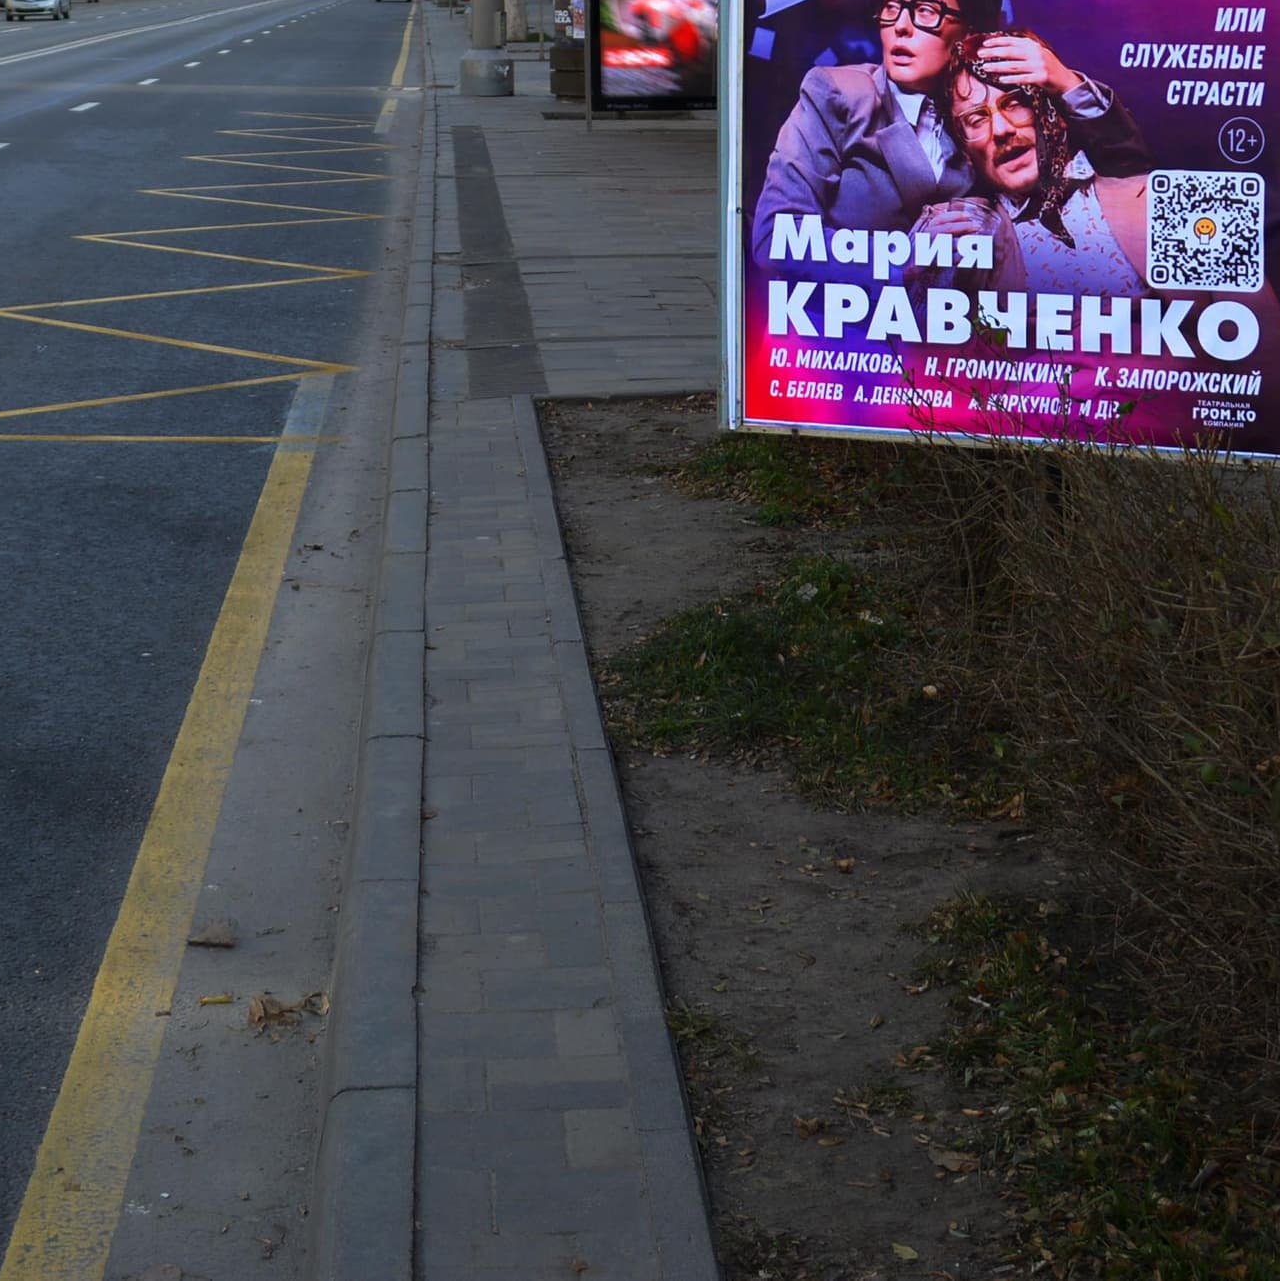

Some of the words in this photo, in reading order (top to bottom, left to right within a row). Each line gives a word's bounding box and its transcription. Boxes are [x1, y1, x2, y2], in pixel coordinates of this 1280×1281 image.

[1215, 7, 1265, 32] ИЛИ
[1120, 42, 1265, 70] СЛУЖЕБНЫЕ
[1166, 81, 1264, 107] СТРАСТИ
[1227, 128, 1258, 153] 12+
[769, 213, 993, 281] Мария
[768, 281, 1260, 361] КРАВЧЕНКО
[770, 349, 792, 368] Ю.
[796, 351, 905, 375] МИХАЛКОВА
[925, 357, 942, 376] Н.
[1095, 366, 1113, 387] К.
[1117, 367, 1262, 396] ЗАПОРОЖСКИЙ
[770, 380, 784, 398] С.
[787, 380, 843, 401] БЕЛЯЕВ
[854, 385, 868, 404] А.
[1198, 399, 1250, 409] ТЕАТРАЛЬНАЯ
[1192, 407, 1257, 422] ГРОМ.КО
[1203, 420, 1244, 429] КОМПАНИЯ
